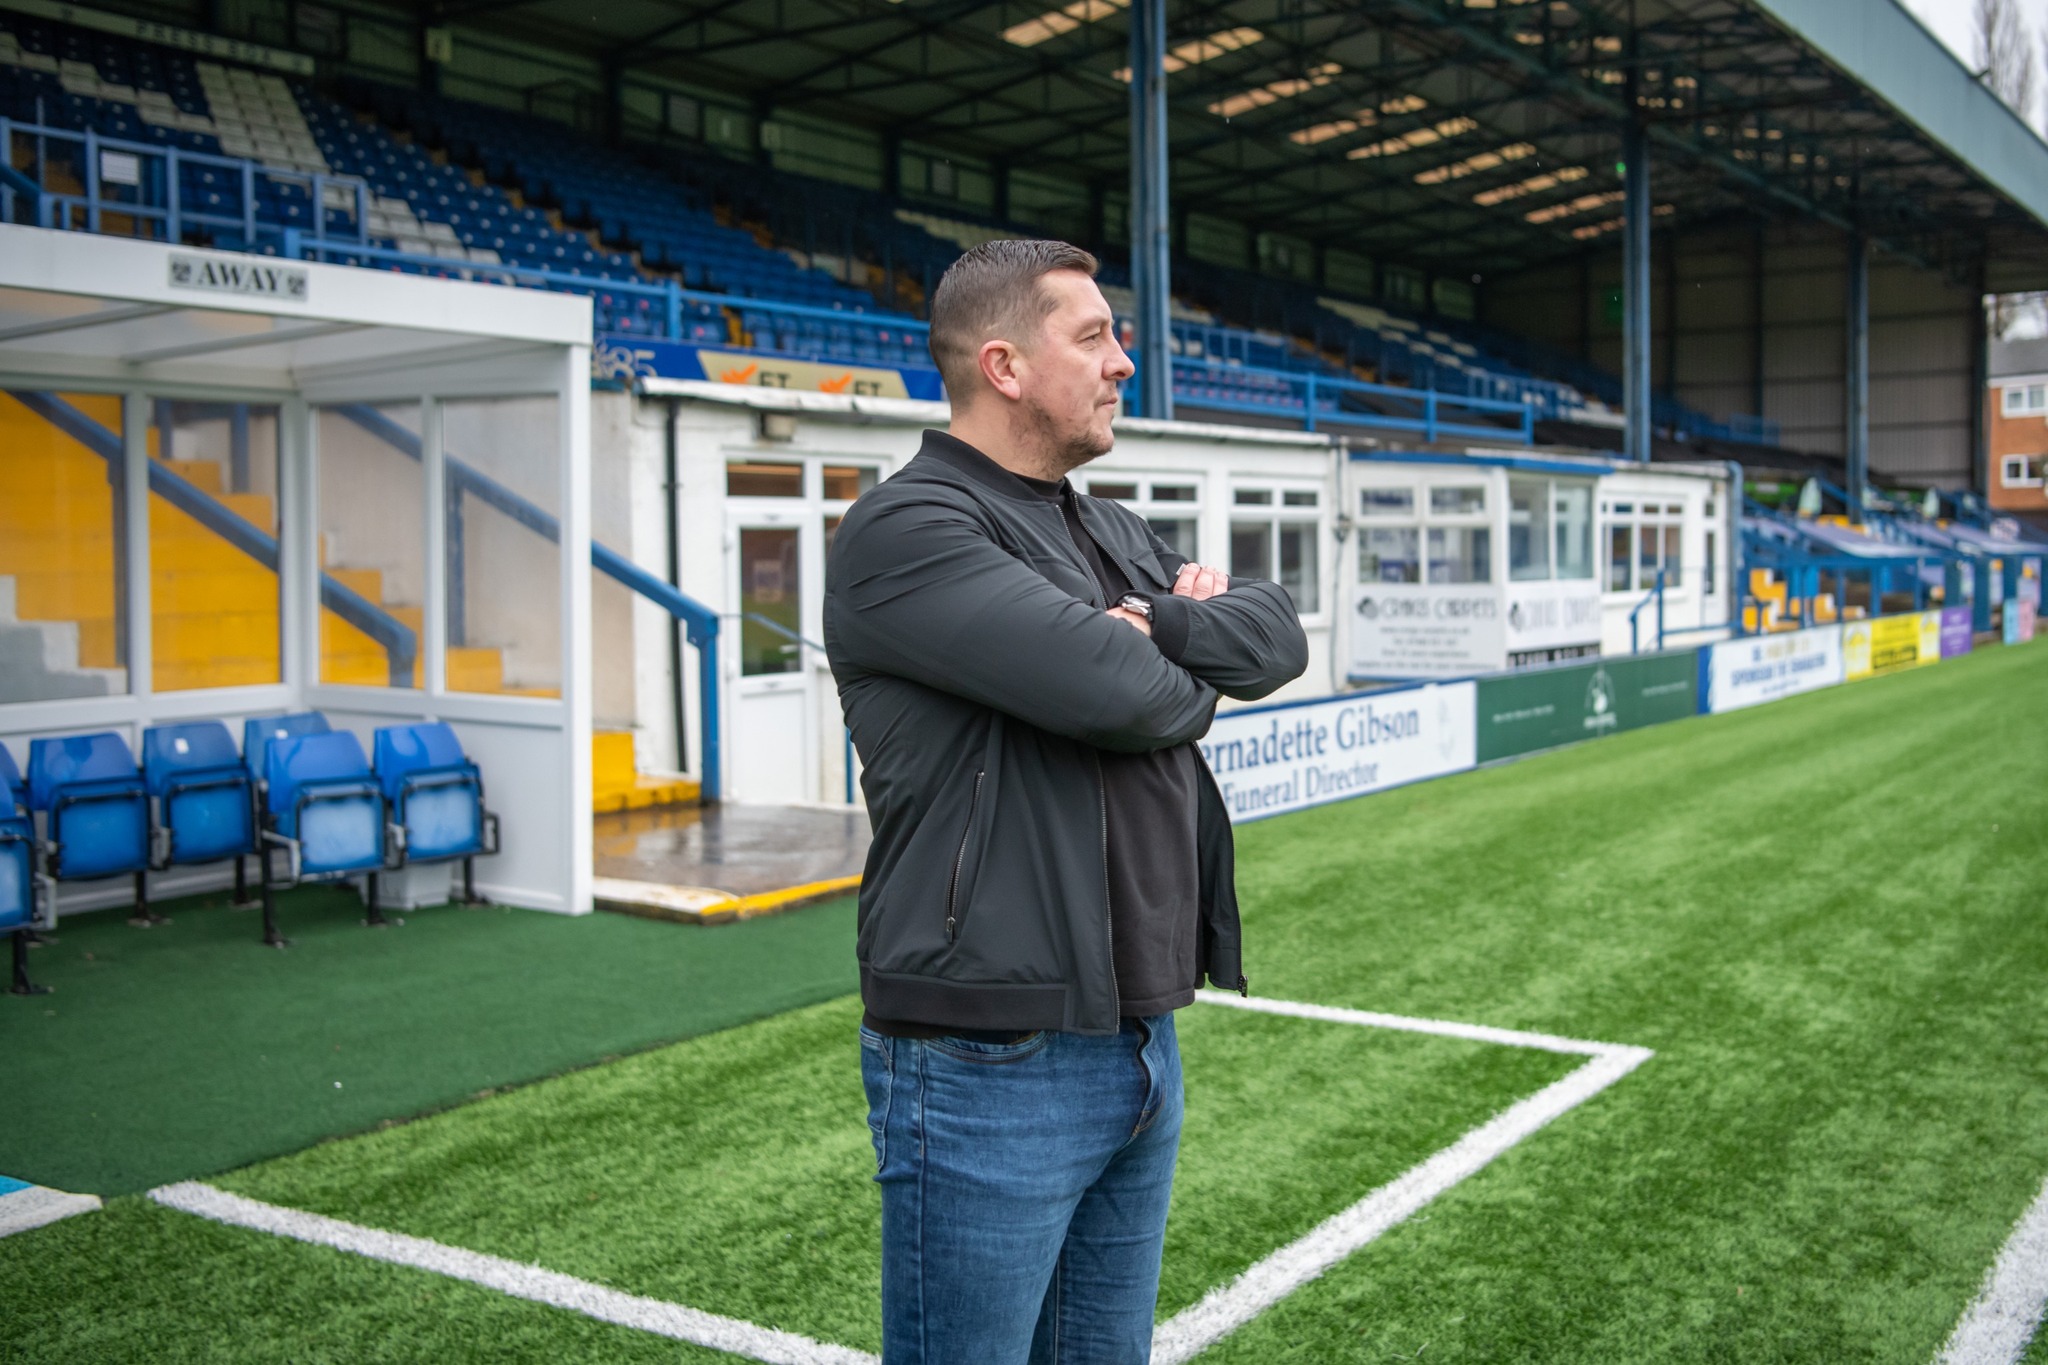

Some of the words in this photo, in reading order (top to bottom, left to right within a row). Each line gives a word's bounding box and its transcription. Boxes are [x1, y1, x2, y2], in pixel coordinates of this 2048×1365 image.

[198, 261, 282, 291] AWAY
[1201, 719, 1327, 774] ernadette
[1336, 704, 1420, 751] Gibson
[1222, 772, 1299, 813] Funeral
[1305, 760, 1379, 798] Director
